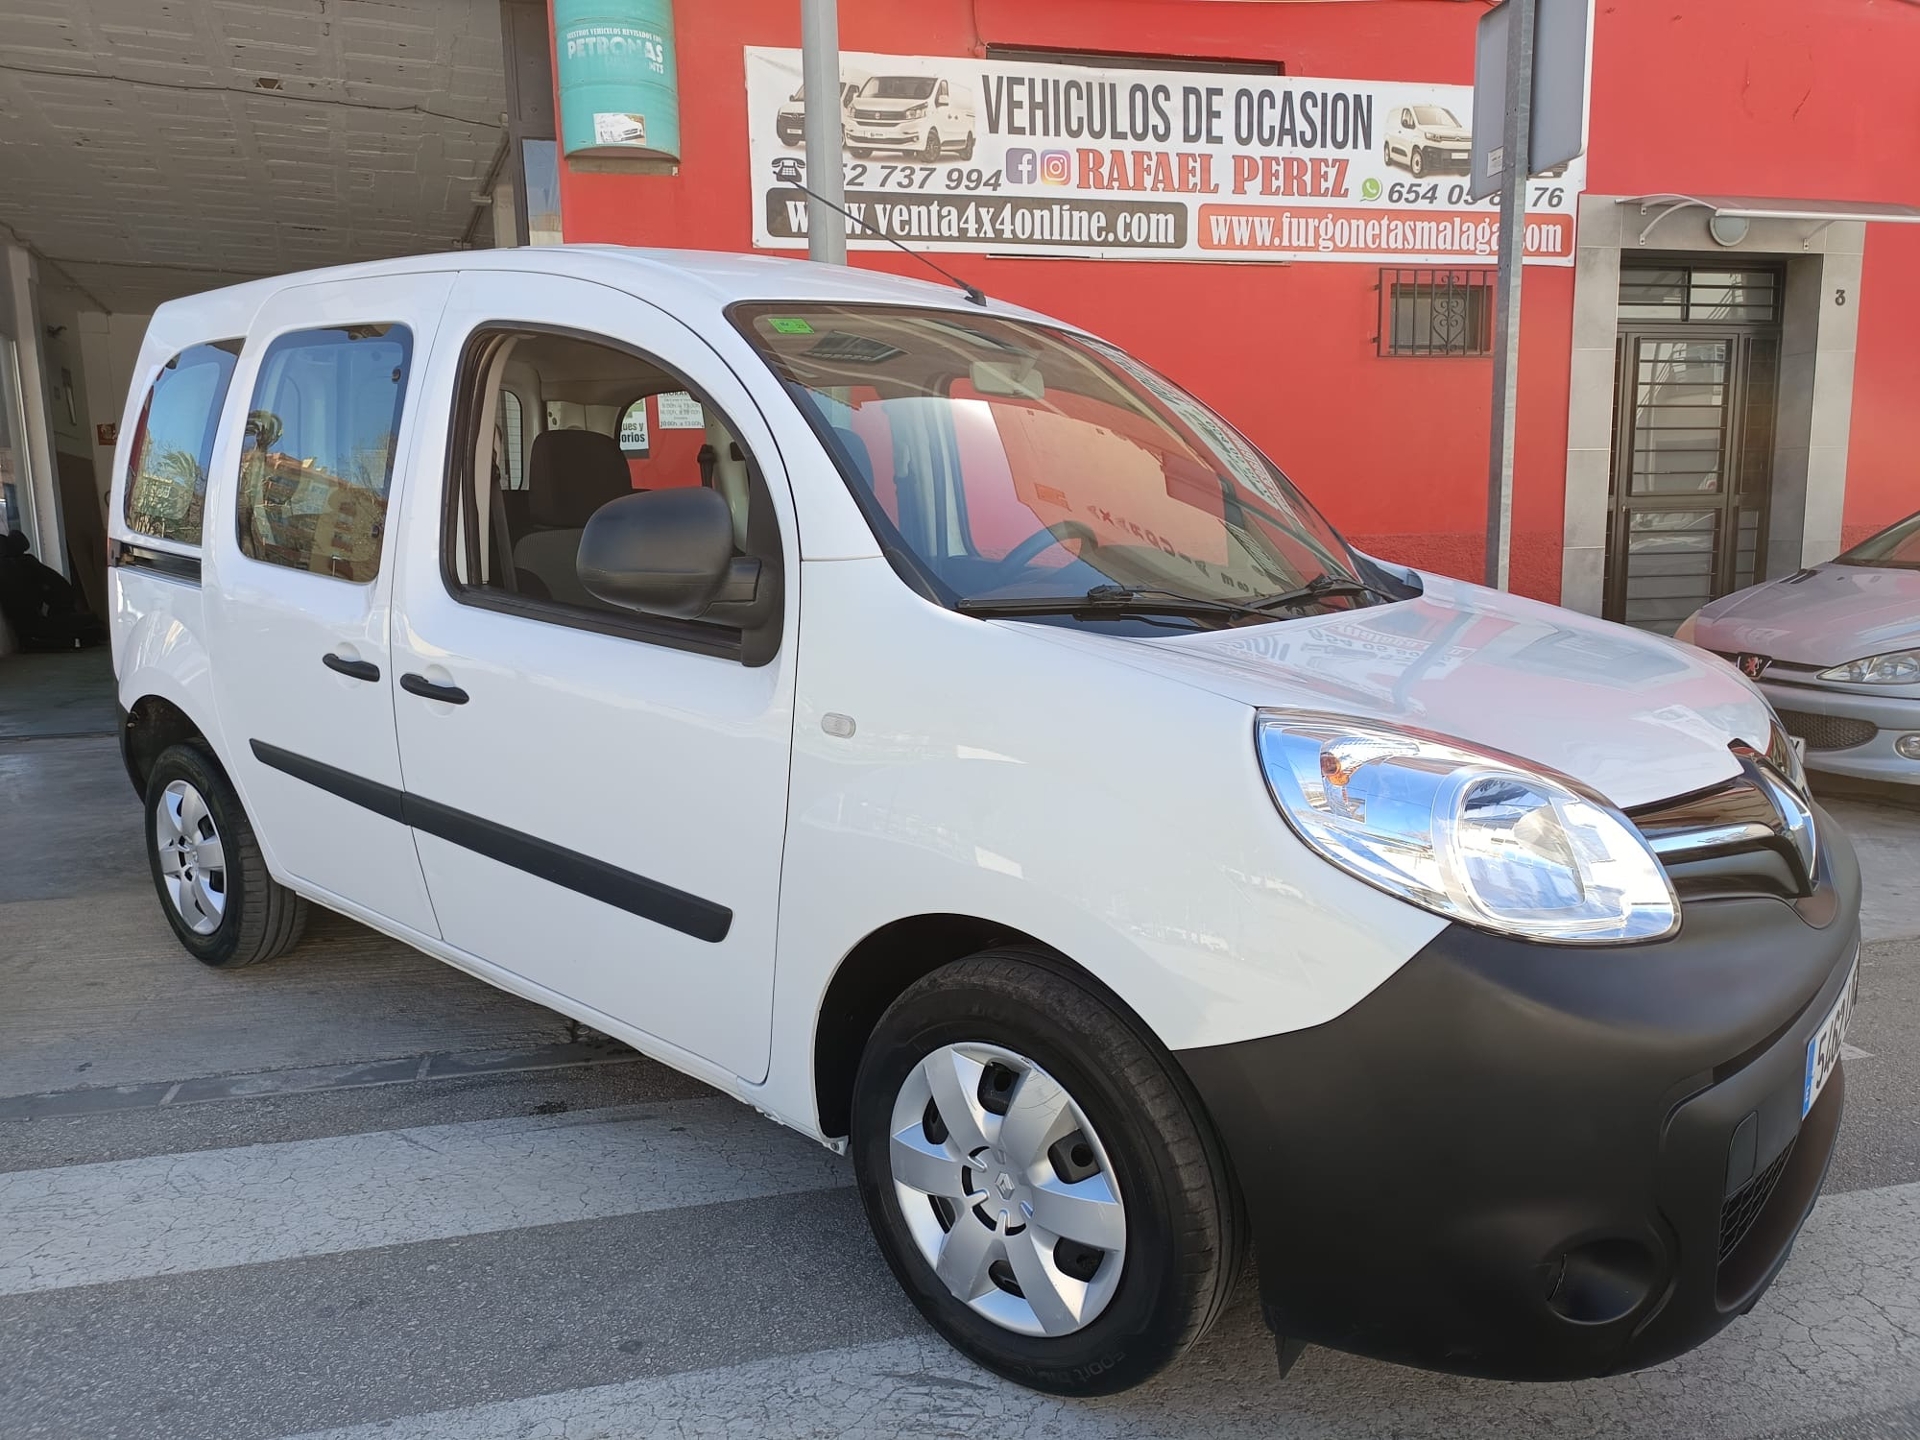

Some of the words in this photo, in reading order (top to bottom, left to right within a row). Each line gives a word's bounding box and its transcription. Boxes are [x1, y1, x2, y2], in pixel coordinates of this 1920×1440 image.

[622, 28, 652, 40] REVISADOS
[567, 36, 663, 63] PETRONAS
[982, 74, 1171, 143] VEHICULOS
[1183, 86, 1224, 144] DE
[1234, 87, 1373, 150] OCASION
[879, 166, 937, 189] 737
[944, 167, 1003, 192] 994
[1076, 148, 1219, 194] RAFAEL
[1231, 155, 1350, 198] PEREZ
[1388, 182, 1439, 205] 654
[1531, 187, 1565, 208] 76
[786, 200, 1175, 244] ww.venta4x4online.com
[1835, 289, 1846, 306] 3
